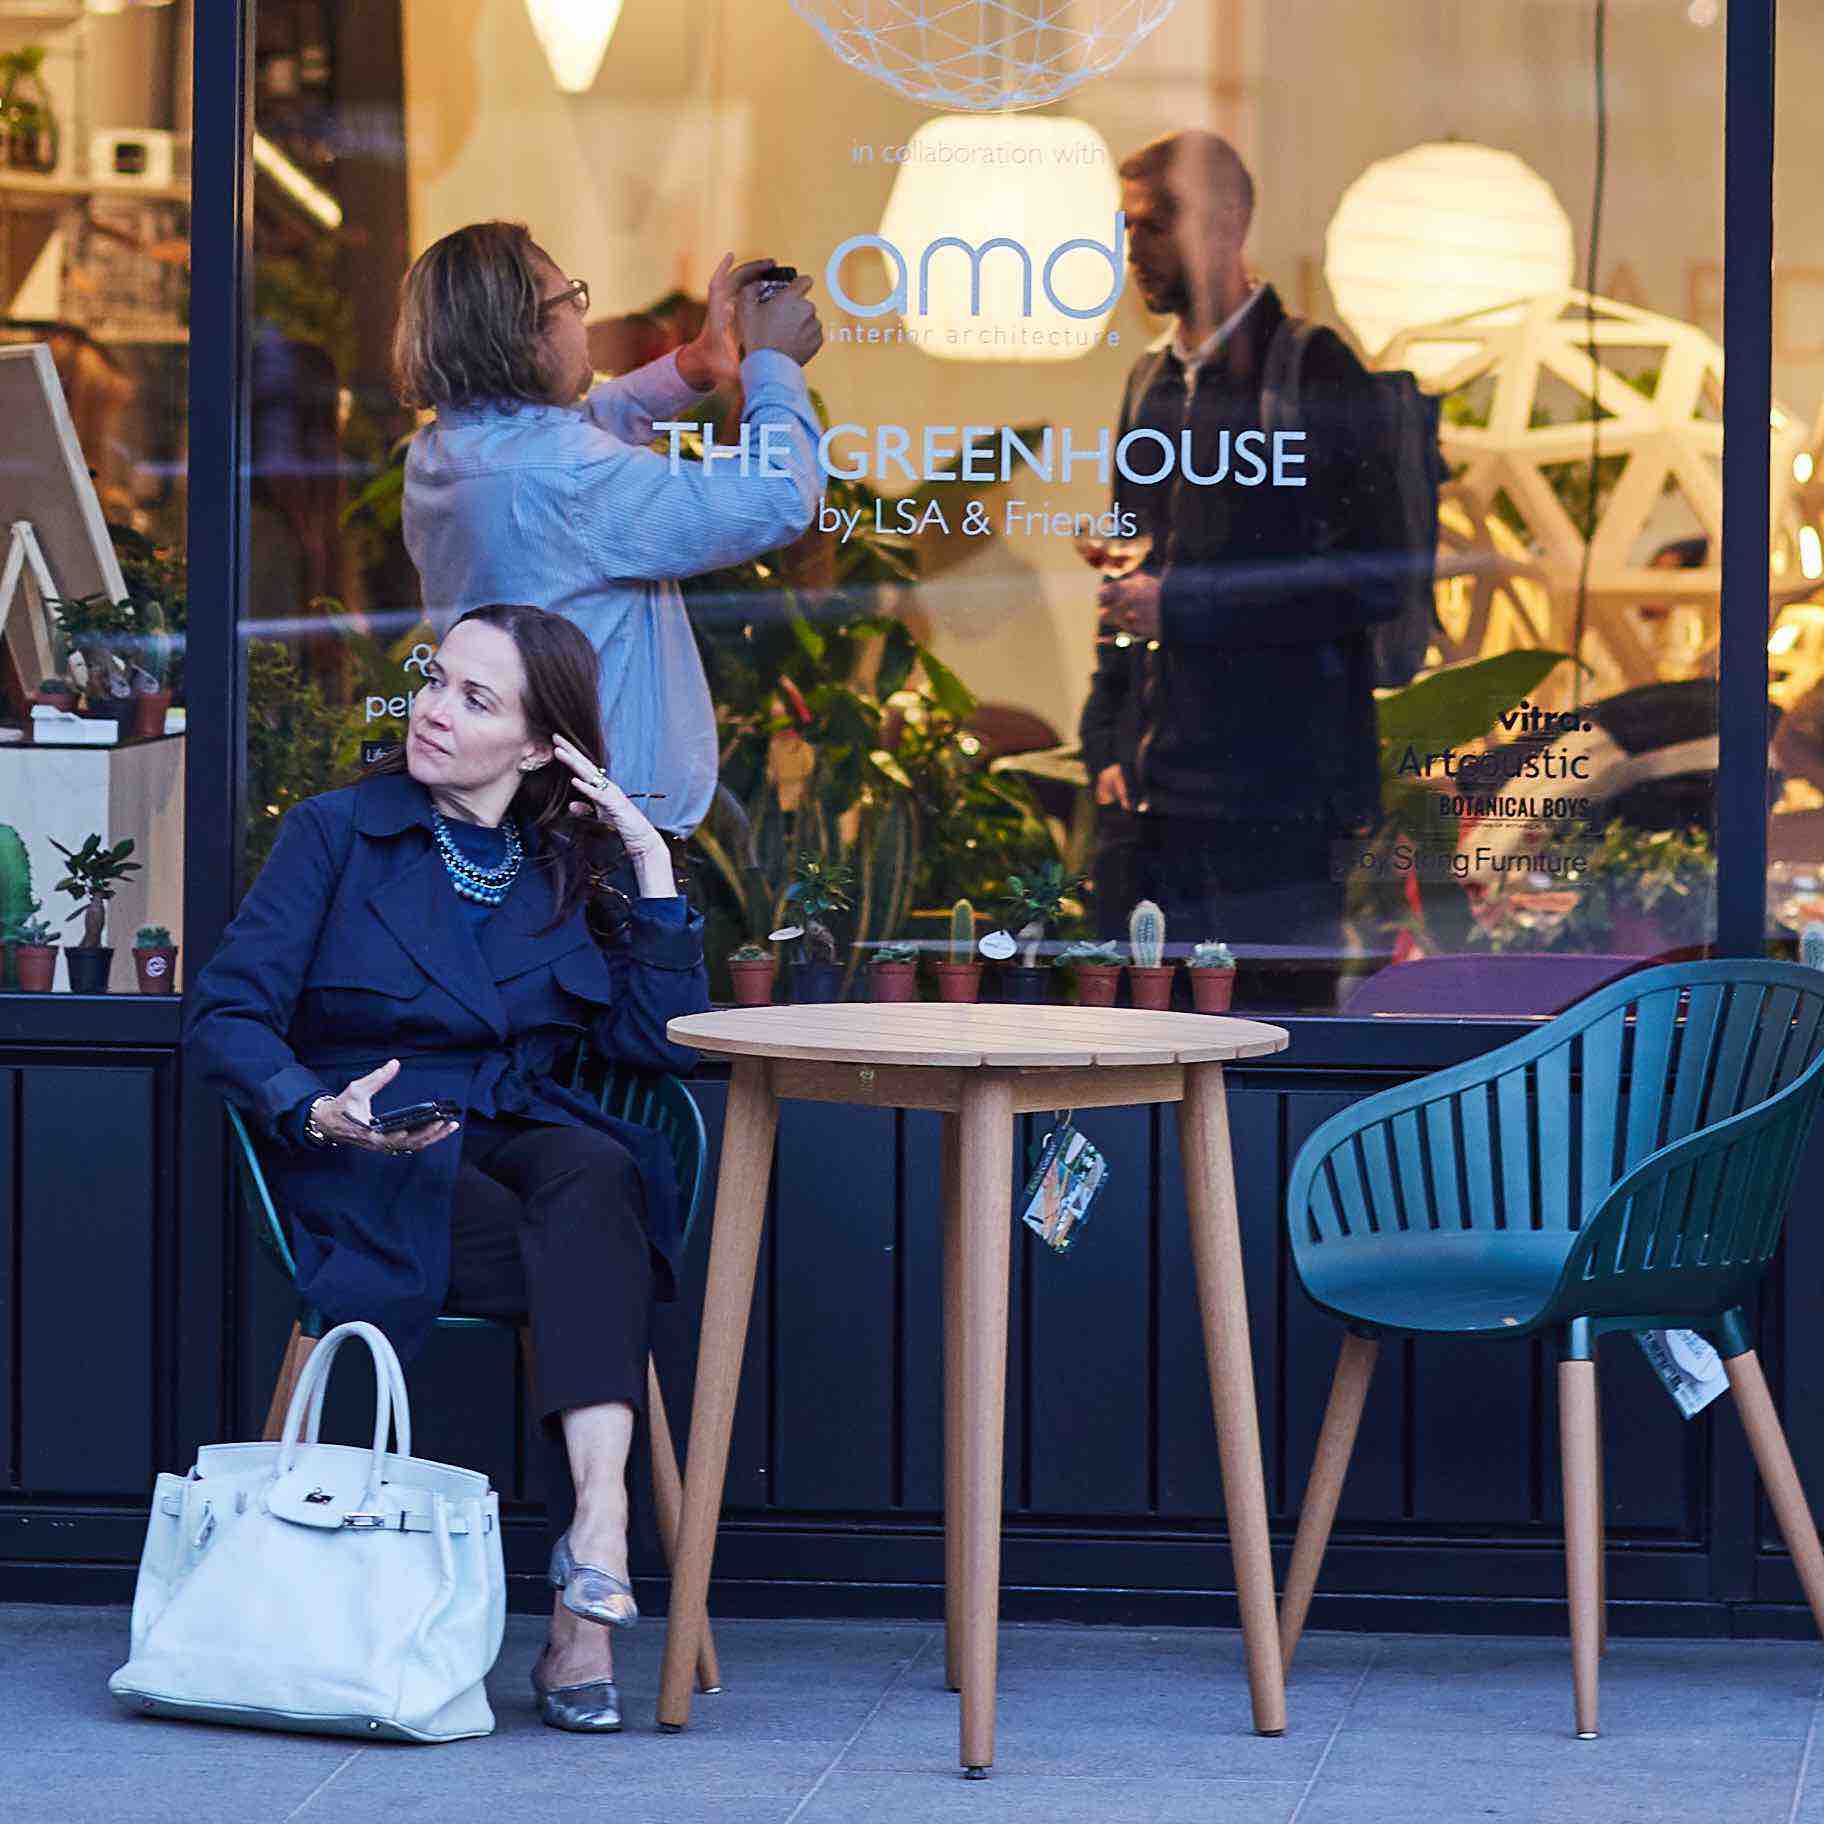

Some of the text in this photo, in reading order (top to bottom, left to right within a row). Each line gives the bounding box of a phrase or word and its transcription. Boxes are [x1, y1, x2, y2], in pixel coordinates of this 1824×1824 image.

[851, 139, 1106, 166] in collaboration with
[826, 210, 1126, 319] amd
[828, 323, 1121, 347] interior architecture
[652, 421, 1308, 488] THE GREENHOUSE
[818, 496, 1138, 544] by LSA & Friends
[1397, 745, 1590, 780] Artcoustic
[1440, 795, 1592, 819] BOTANICAL BOYS
[1475, 847, 1587, 873] Furniture
